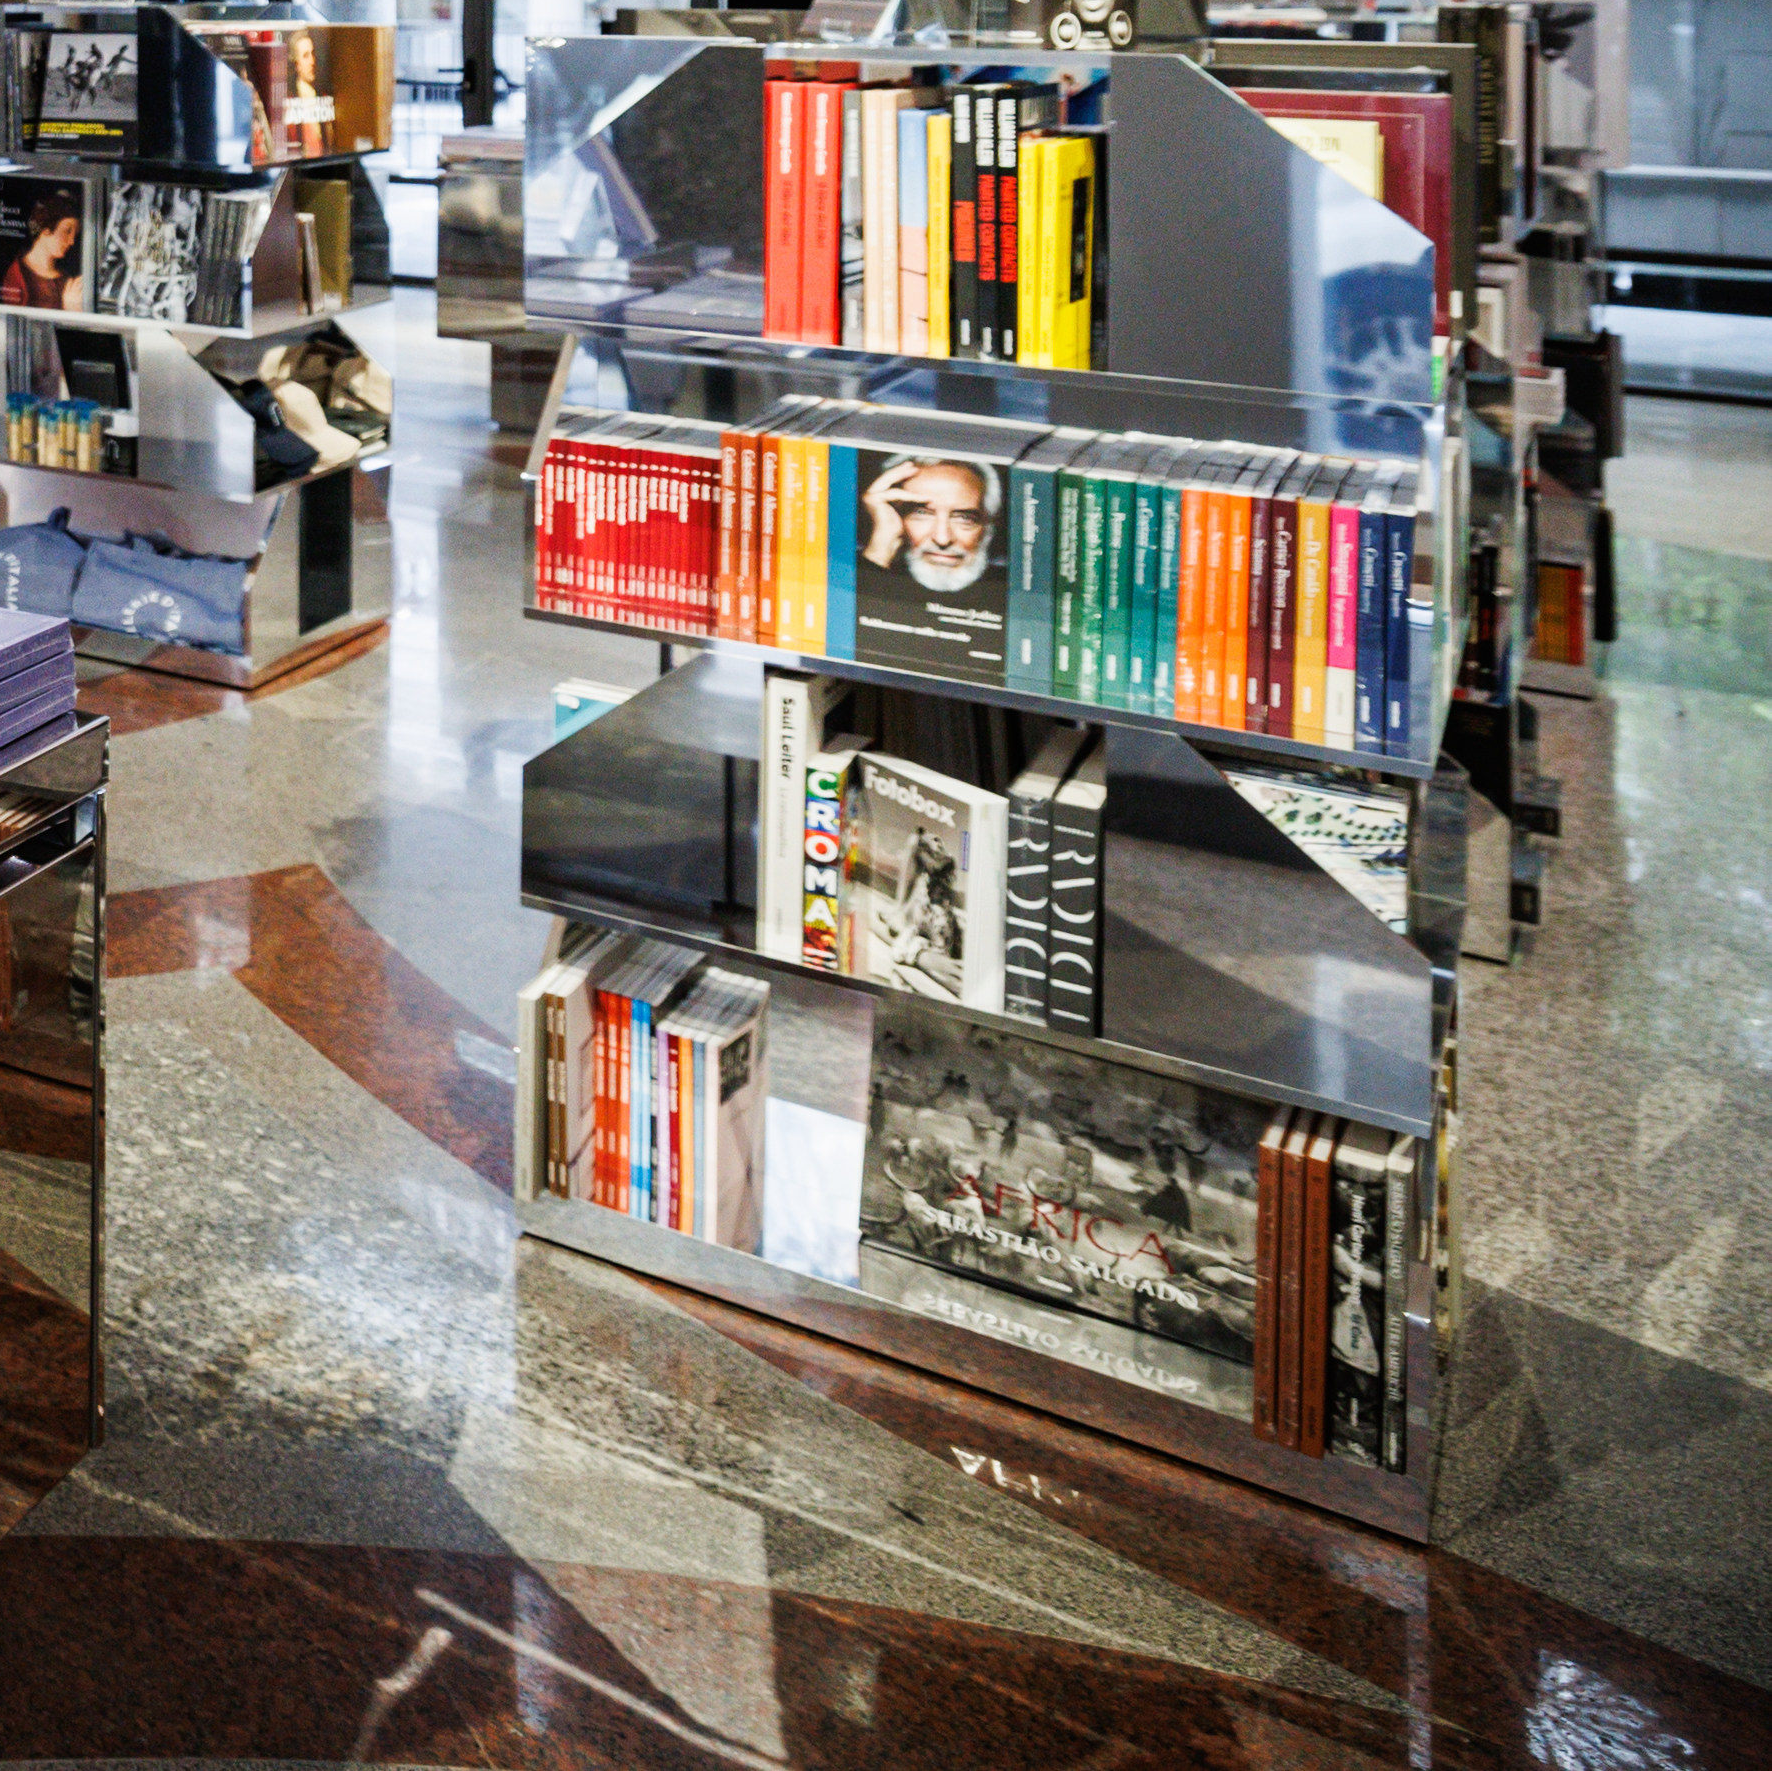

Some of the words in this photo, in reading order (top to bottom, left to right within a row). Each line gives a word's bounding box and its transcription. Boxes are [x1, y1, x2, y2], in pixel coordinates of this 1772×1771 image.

[976, 98, 994, 138] WILLIAM
[998, 99, 1017, 139] WILLIAM
[976, 138, 994, 166] KLEIN
[998, 140, 1017, 168] KLEIN
[978, 174, 995, 221] PAINTED
[1000, 176, 1017, 223] PAINTED
[978, 223, 995, 281] CONTACTS
[1000, 225, 1017, 282] CONTACTS
[780, 696, 796, 730] Saul
[780, 735, 794, 780] Leiter
[864, 764, 957, 828] Fotobox
[804, 771, 839, 927] CROMA
[945, 1175, 1175, 1275] AFRICA
[1349, 1194, 1366, 1222] Henri
[922, 1208, 1061, 1265] SEBASTIÃO
[1069, 1254, 1203, 1312] SALGADO
[1349, 1224, 1366, 1308] Cartier-Bresson
[1388, 1313, 1403, 1350] ALTRE
[1388, 1352, 1403, 1401] AMERICHE
